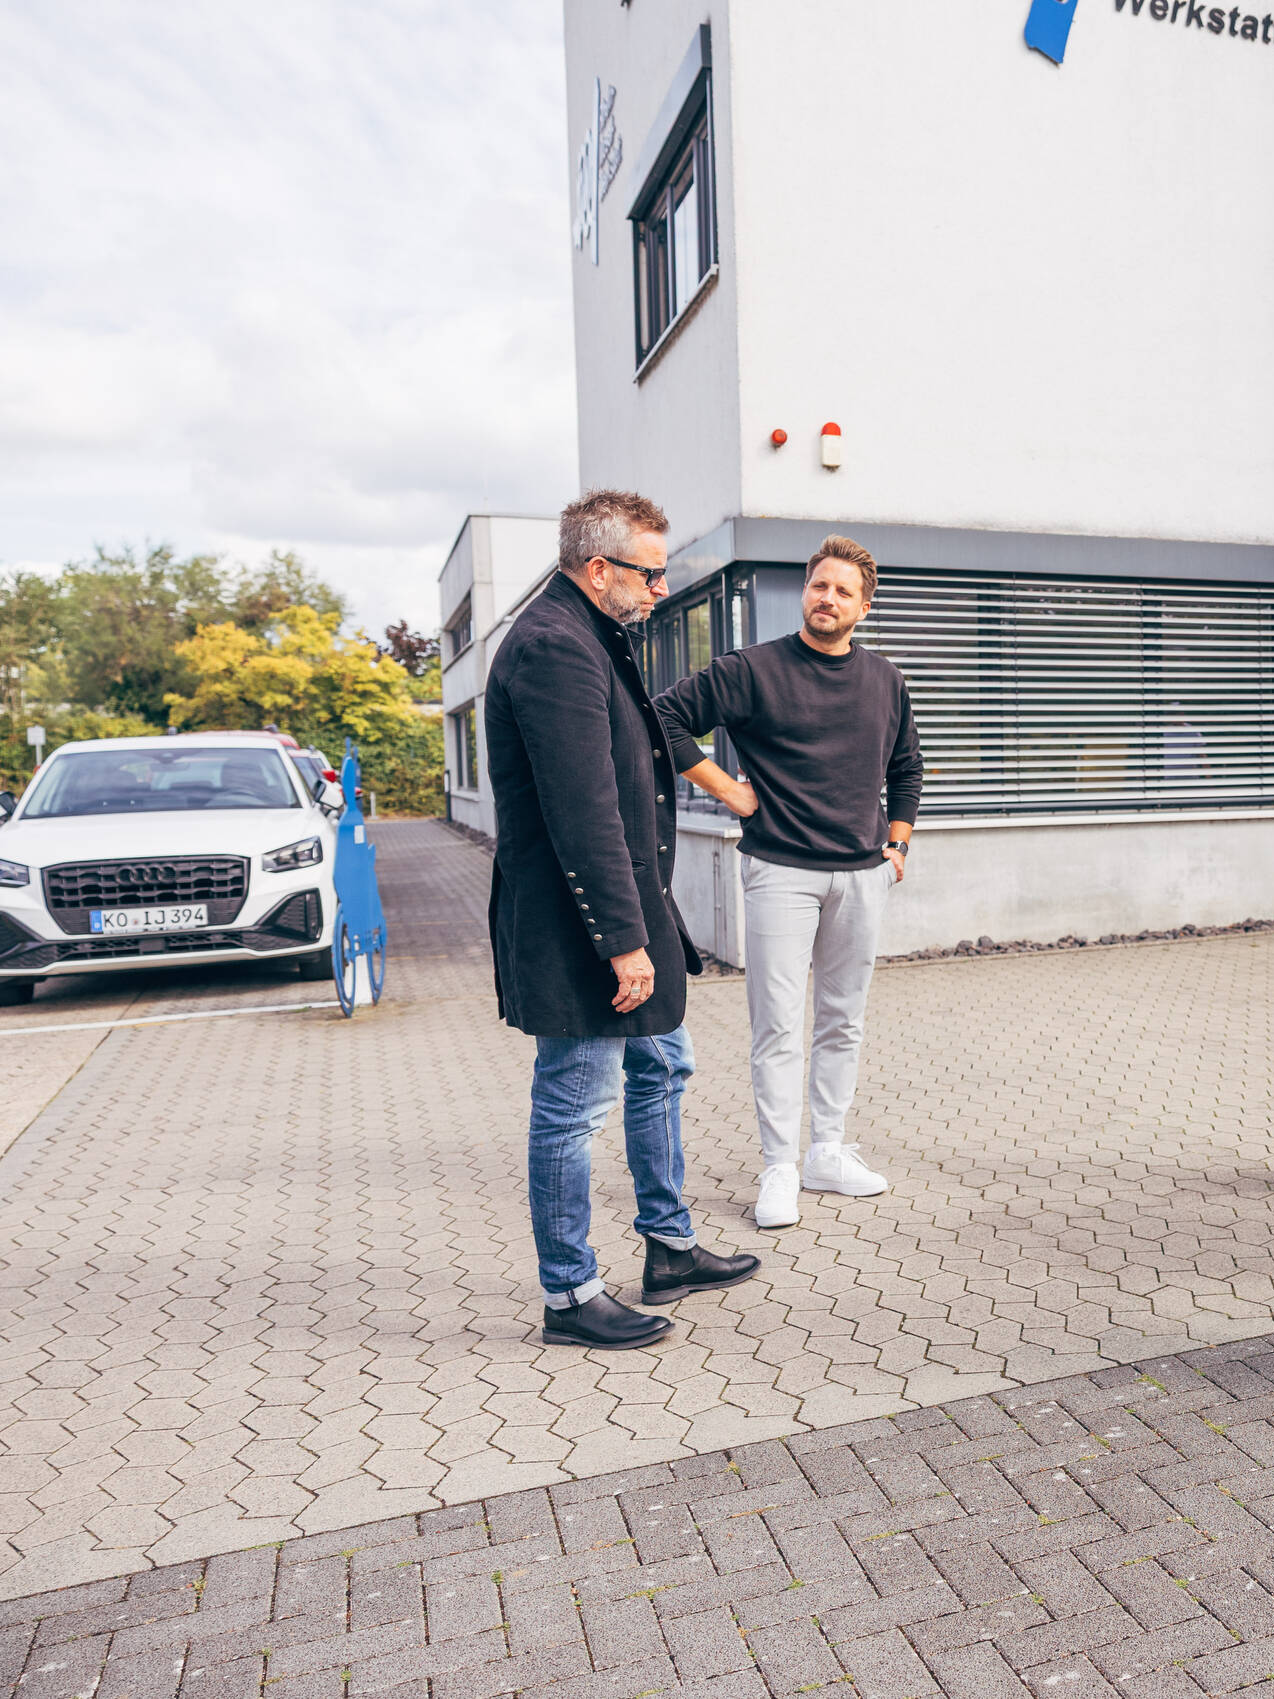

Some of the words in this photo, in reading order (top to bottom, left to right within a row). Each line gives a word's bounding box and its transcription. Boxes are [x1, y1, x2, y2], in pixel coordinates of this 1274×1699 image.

[103, 912, 128, 928] KO
[143, 910, 166, 925] IJ
[170, 907, 204, 924] 394
